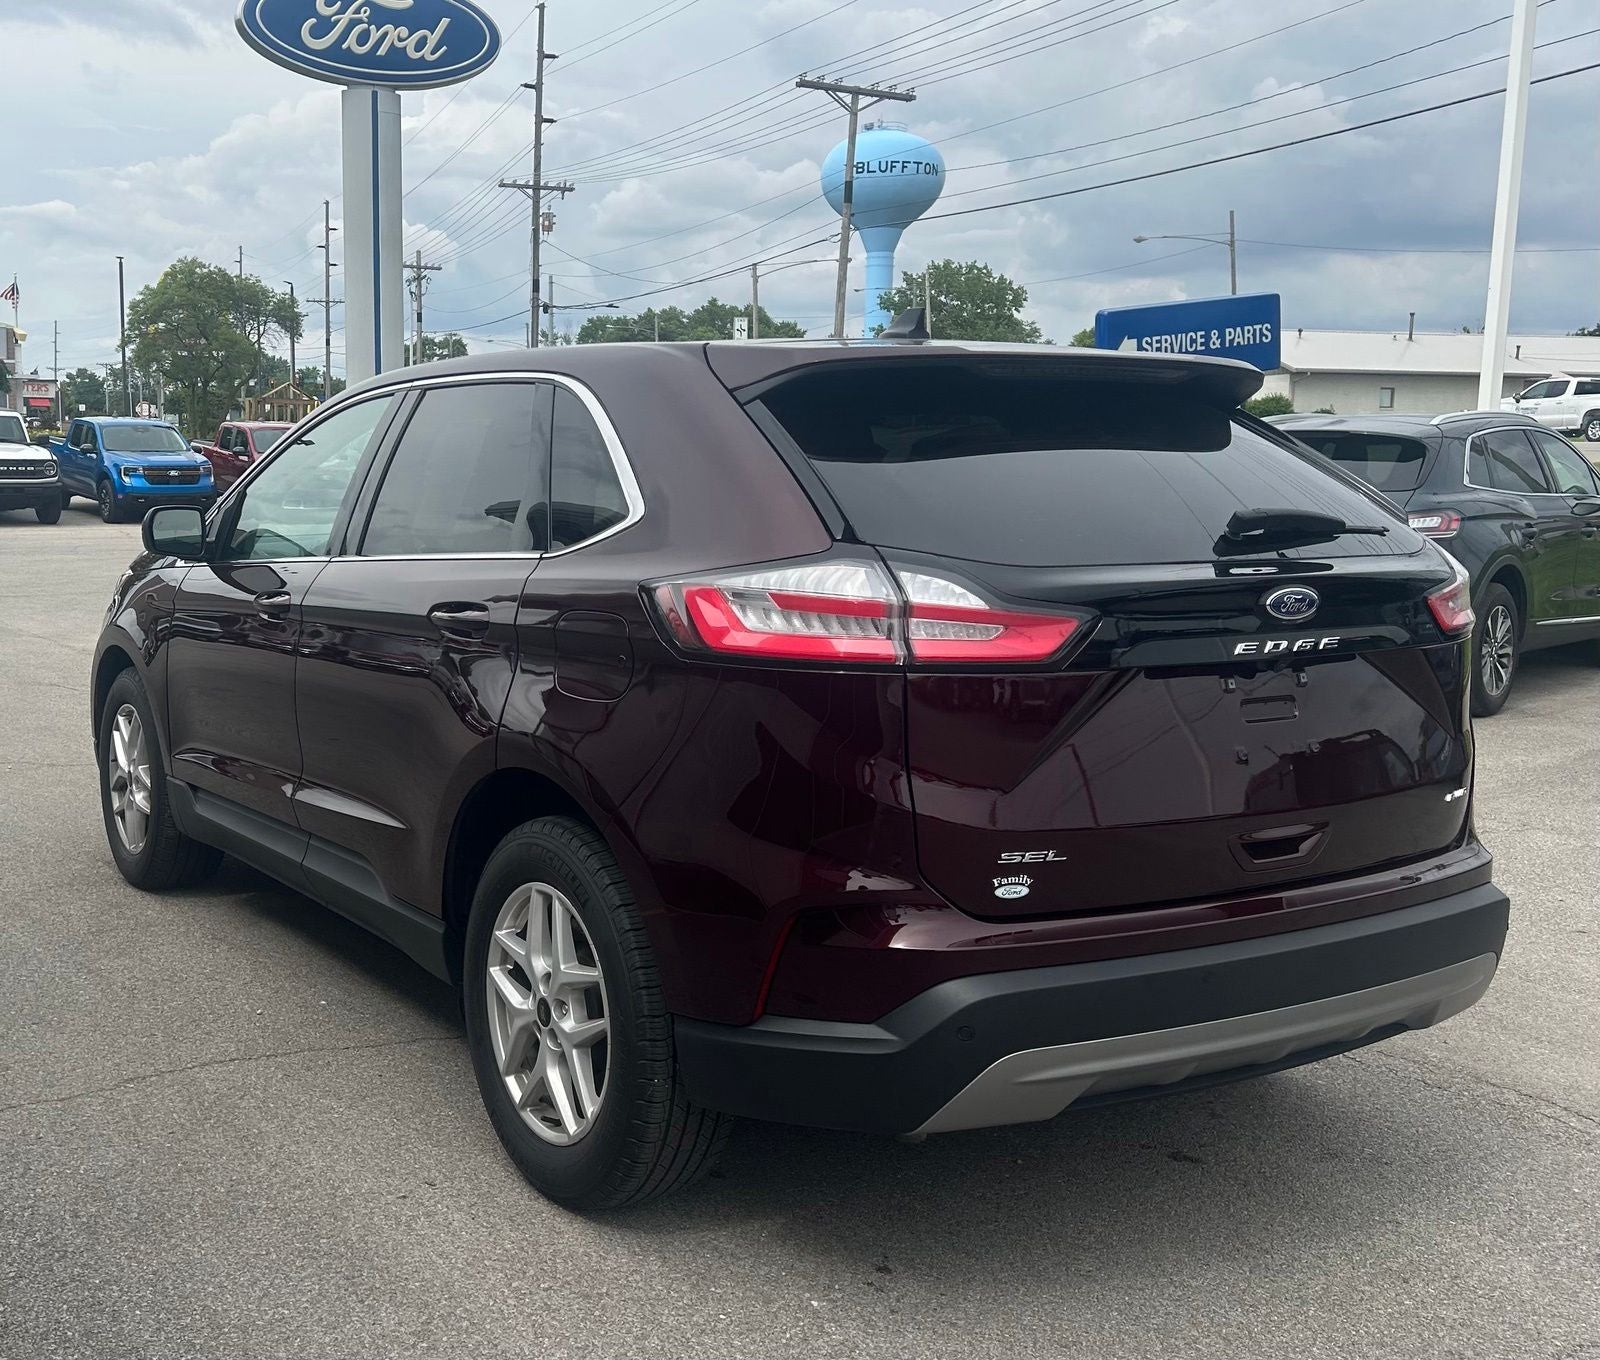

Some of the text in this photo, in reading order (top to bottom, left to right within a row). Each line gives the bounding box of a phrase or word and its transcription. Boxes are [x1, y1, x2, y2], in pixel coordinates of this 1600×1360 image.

[301, 0, 451, 61] Ford
[855, 160, 939, 177] BLUFFTON
[1141, 323, 1272, 353] SERVICE & PARTS
[1280, 594, 1309, 612] Ford
[1233, 636, 1341, 656] EDGE
[997, 849, 1067, 864] SEL
[992, 874, 1034, 887] Family
[1001, 886, 1024, 896] Ford
